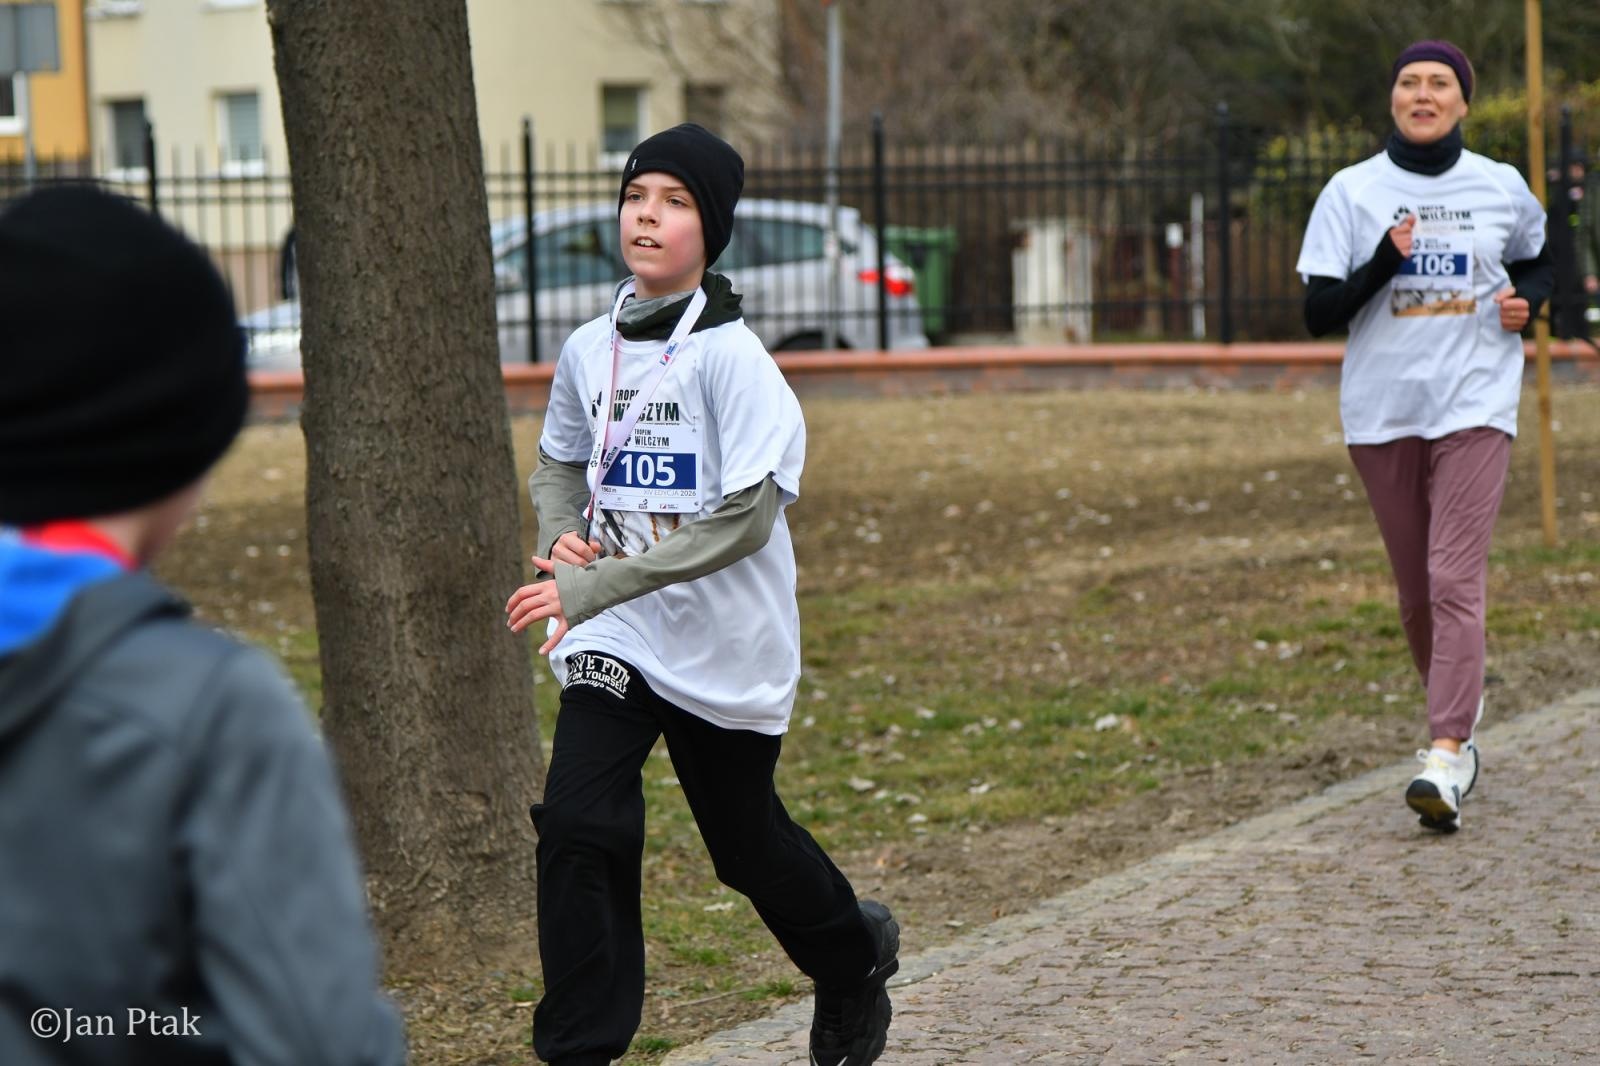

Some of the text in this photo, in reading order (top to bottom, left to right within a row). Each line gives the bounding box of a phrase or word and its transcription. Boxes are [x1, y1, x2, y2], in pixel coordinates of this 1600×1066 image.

[1412, 254, 1456, 275] 106
[615, 389, 640, 401] TROP
[613, 402, 680, 420] WCZYM
[635, 436, 669, 446] WILCZYM
[620, 453, 676, 486] 105
[680, 489, 697, 497] 2026
[601, 659, 631, 686] FUN
[574, 678, 605, 688] always
[586, 671, 627, 693] YOURSELF
